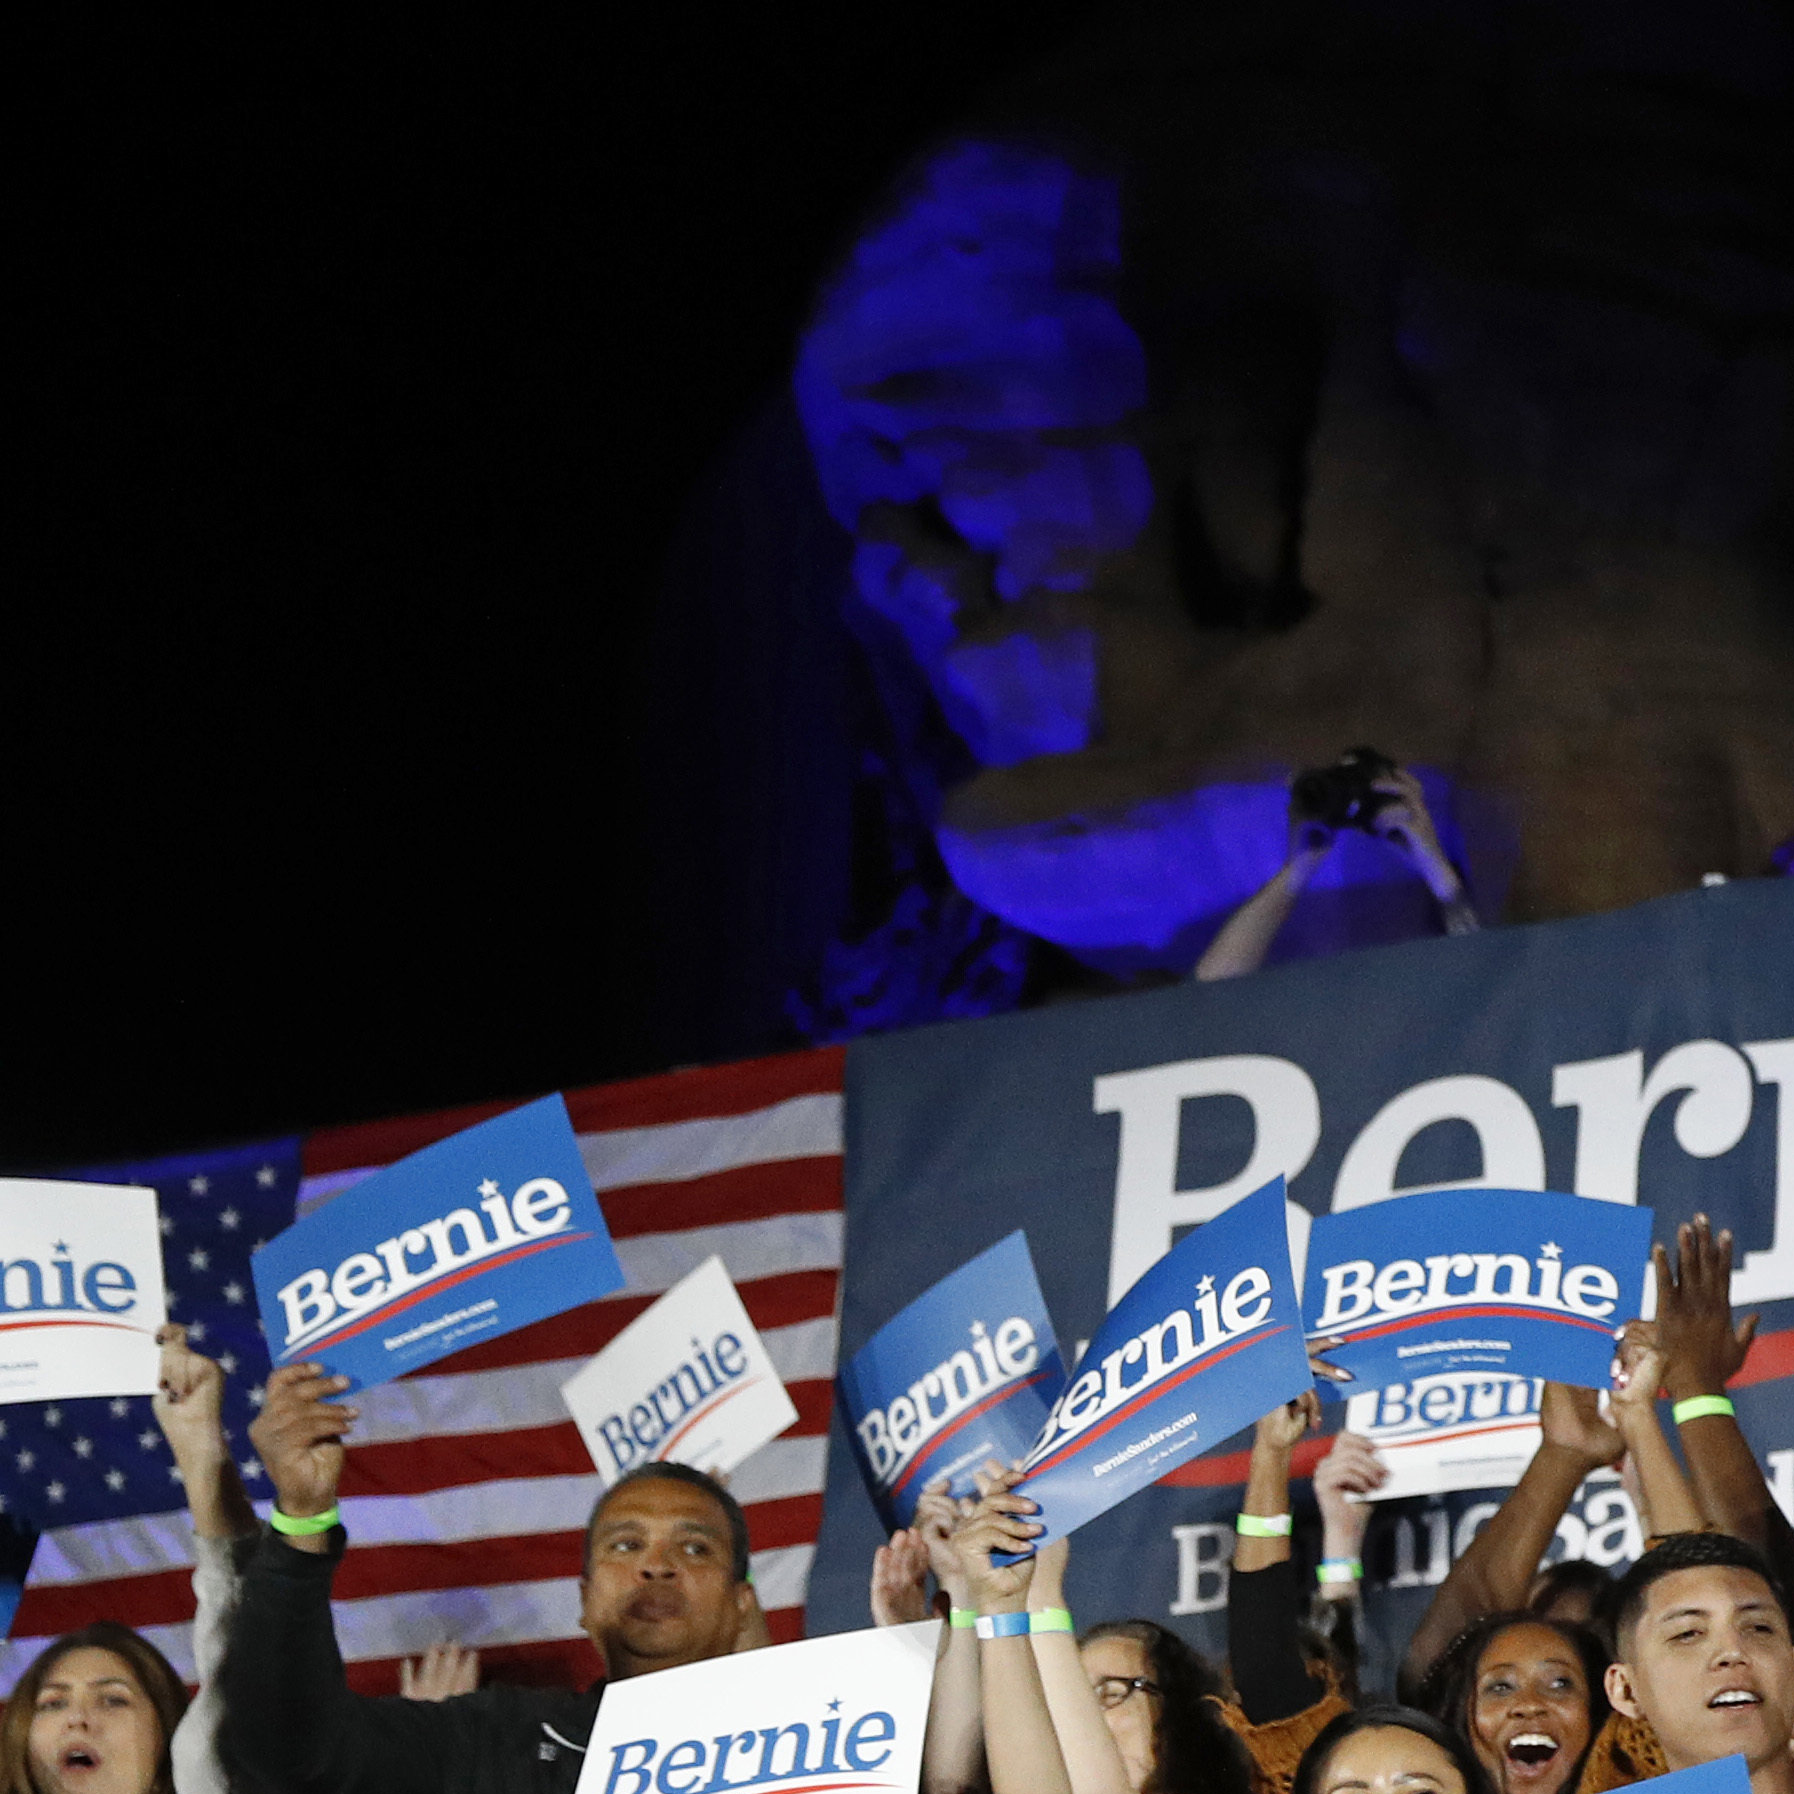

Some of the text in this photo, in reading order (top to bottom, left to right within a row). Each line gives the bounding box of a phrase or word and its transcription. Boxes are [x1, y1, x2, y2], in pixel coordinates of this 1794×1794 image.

[0, 1238, 136, 1313] nie
[277, 1178, 572, 1346] Bernie
[1315, 1241, 1620, 1330] Bernie
[596, 1331, 748, 1470] Bernie
[856, 1316, 1039, 1483] Bernie
[1368, 1378, 1540, 1428] Bern
